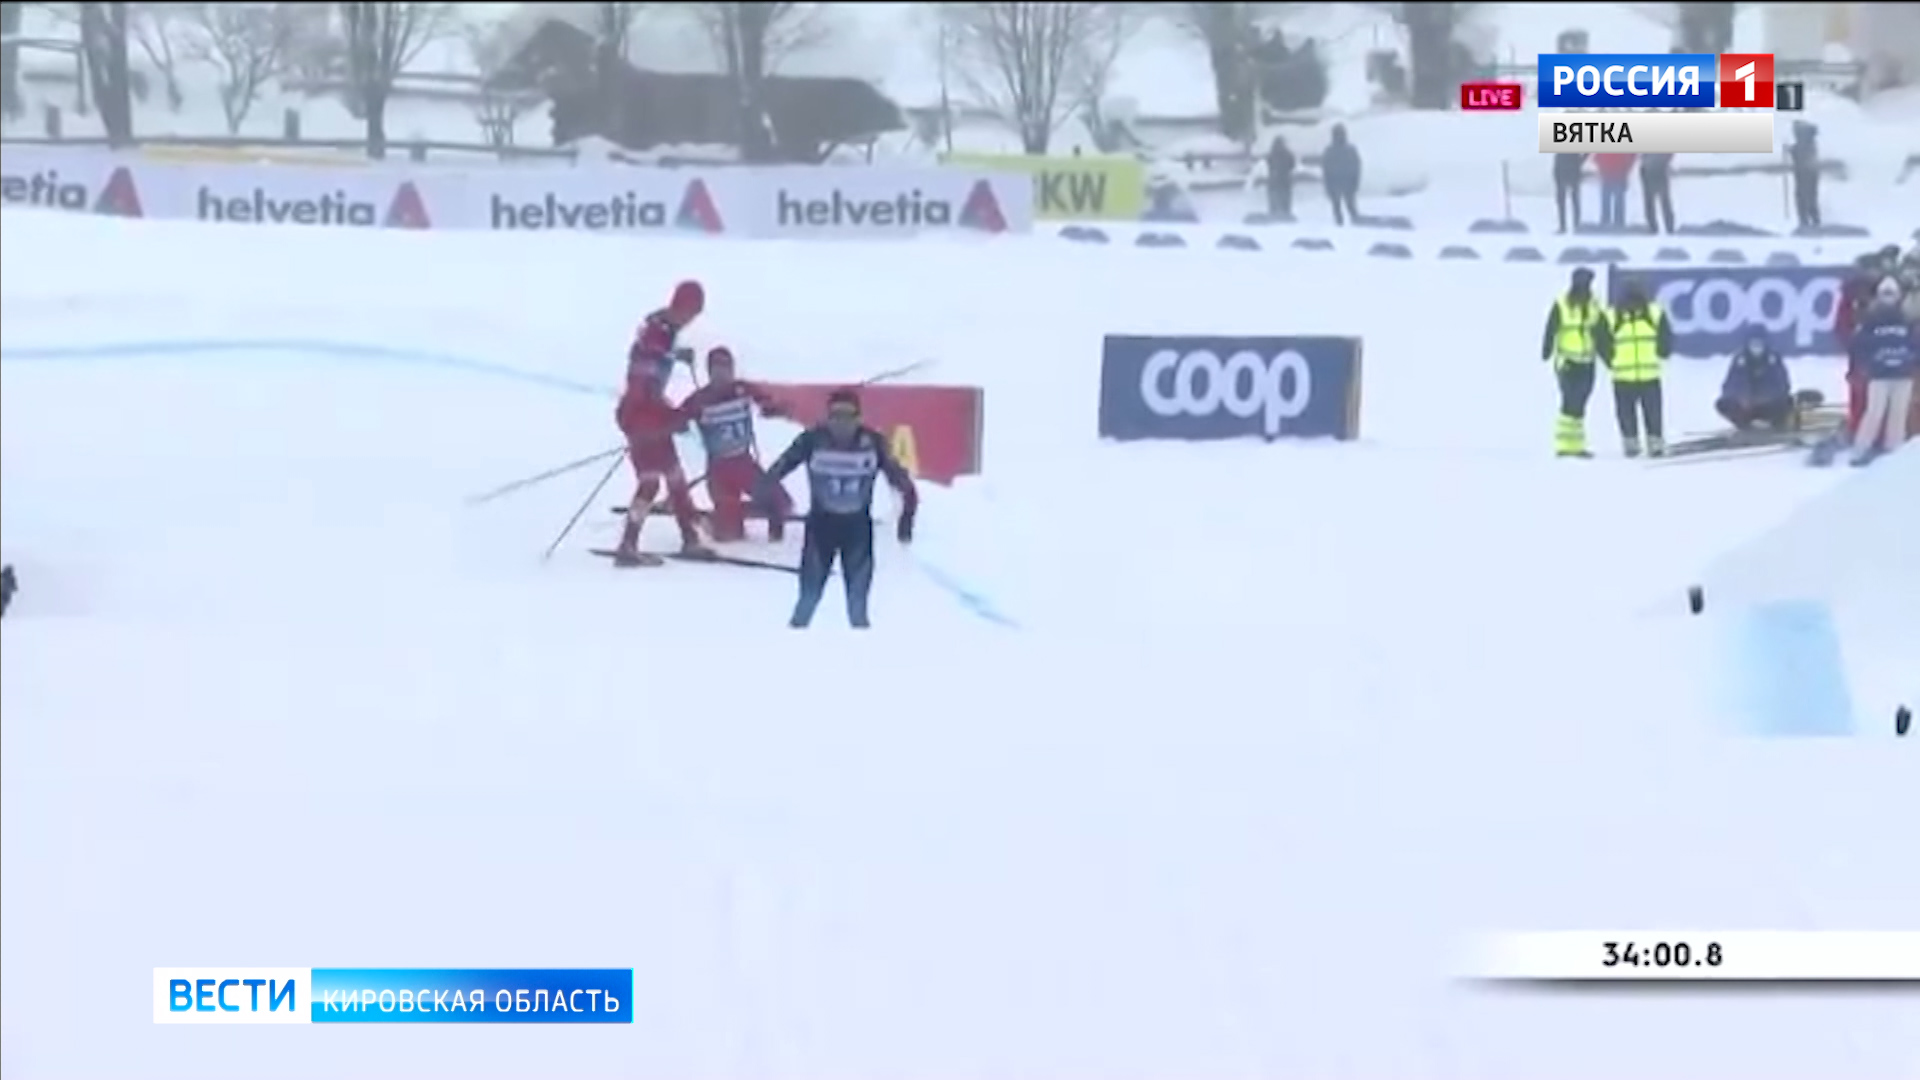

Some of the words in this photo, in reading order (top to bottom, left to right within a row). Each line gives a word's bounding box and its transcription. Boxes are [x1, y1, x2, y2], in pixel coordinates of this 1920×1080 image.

[198, 187, 376, 226] helvetia
[490, 192, 666, 230] helvetia
[777, 189, 951, 227] helvetia
[1032, 171, 1106, 212] KW
[1656, 276, 1842, 347] coop
[1140, 350, 1311, 435] coop
